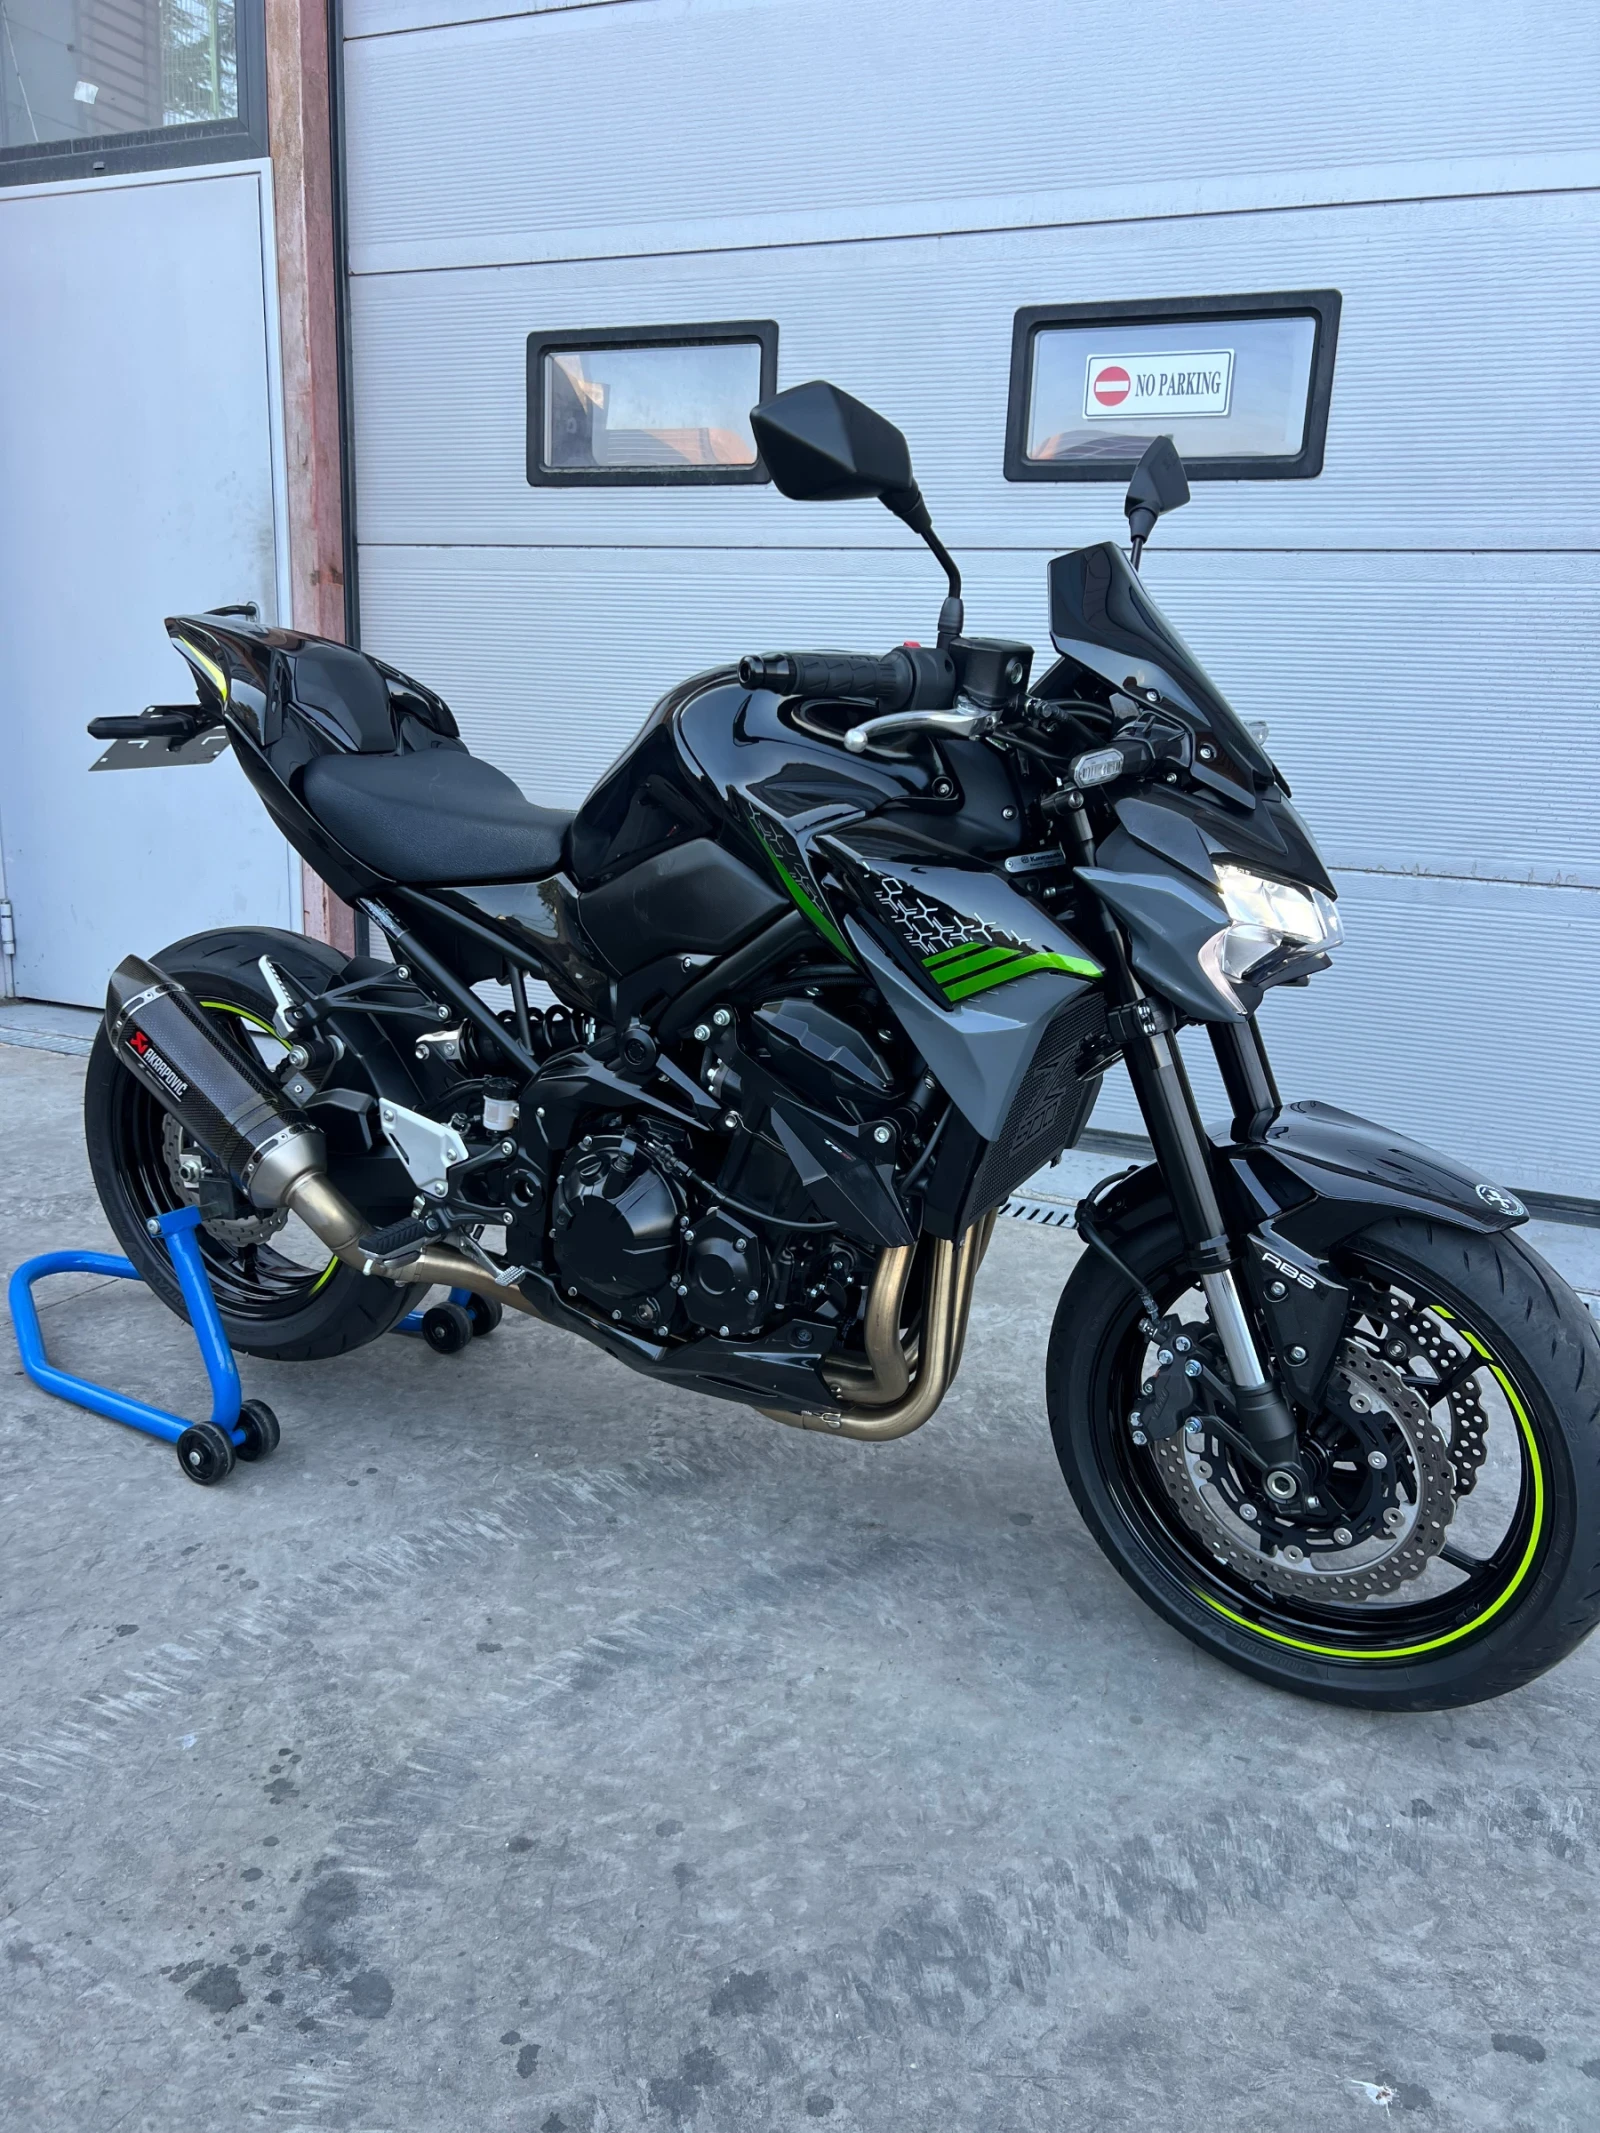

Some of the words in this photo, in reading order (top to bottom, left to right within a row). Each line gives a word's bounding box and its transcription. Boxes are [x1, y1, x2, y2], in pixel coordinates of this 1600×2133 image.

[1135, 373, 1155, 397] NO
[1158, 371, 1221, 396] PARKING
[143, 1048, 188, 1096] AKRAPOVIČ
[1262, 1252, 1317, 1289] ABS
